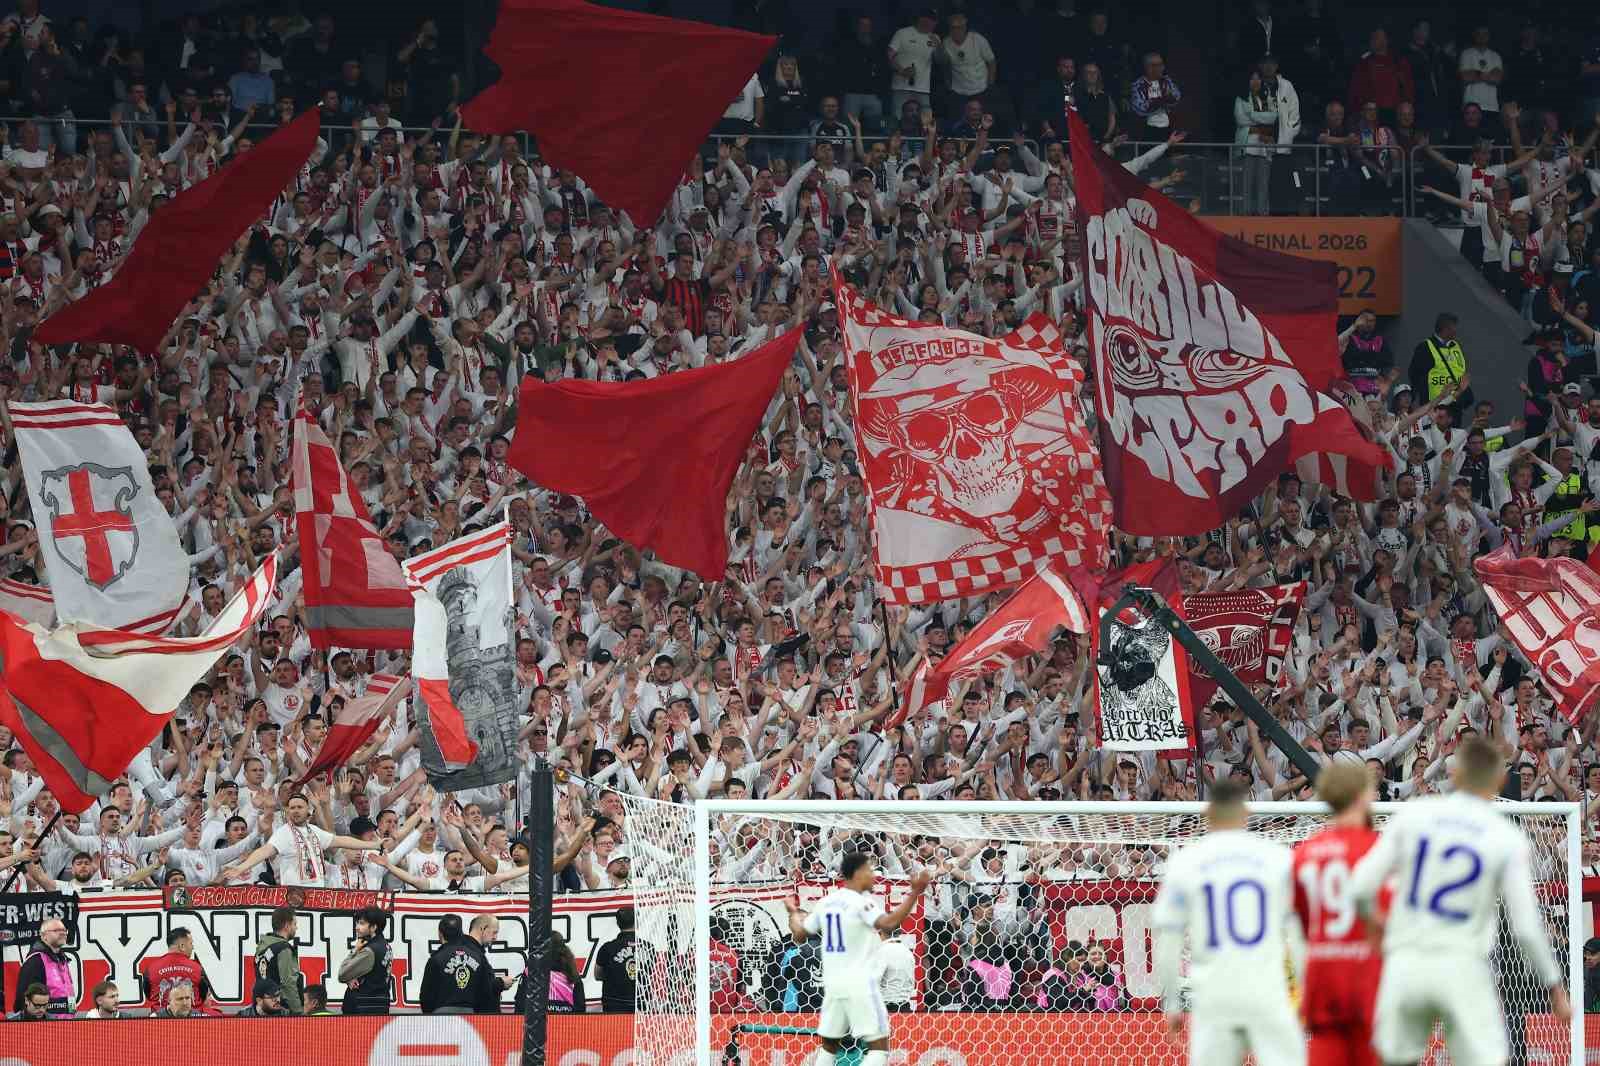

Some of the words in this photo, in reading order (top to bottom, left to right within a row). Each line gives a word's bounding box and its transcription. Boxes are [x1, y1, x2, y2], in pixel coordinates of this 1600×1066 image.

[1254, 233, 1312, 250] FINAL
[1318, 234, 1368, 250] 2026
[191, 886, 244, 909] SPORT
[248, 886, 287, 907] CLUB
[1298, 860, 1356, 940] 19
[1406, 835, 1485, 923] 12
[825, 912, 846, 953] 11
[1203, 878, 1267, 949] 10
